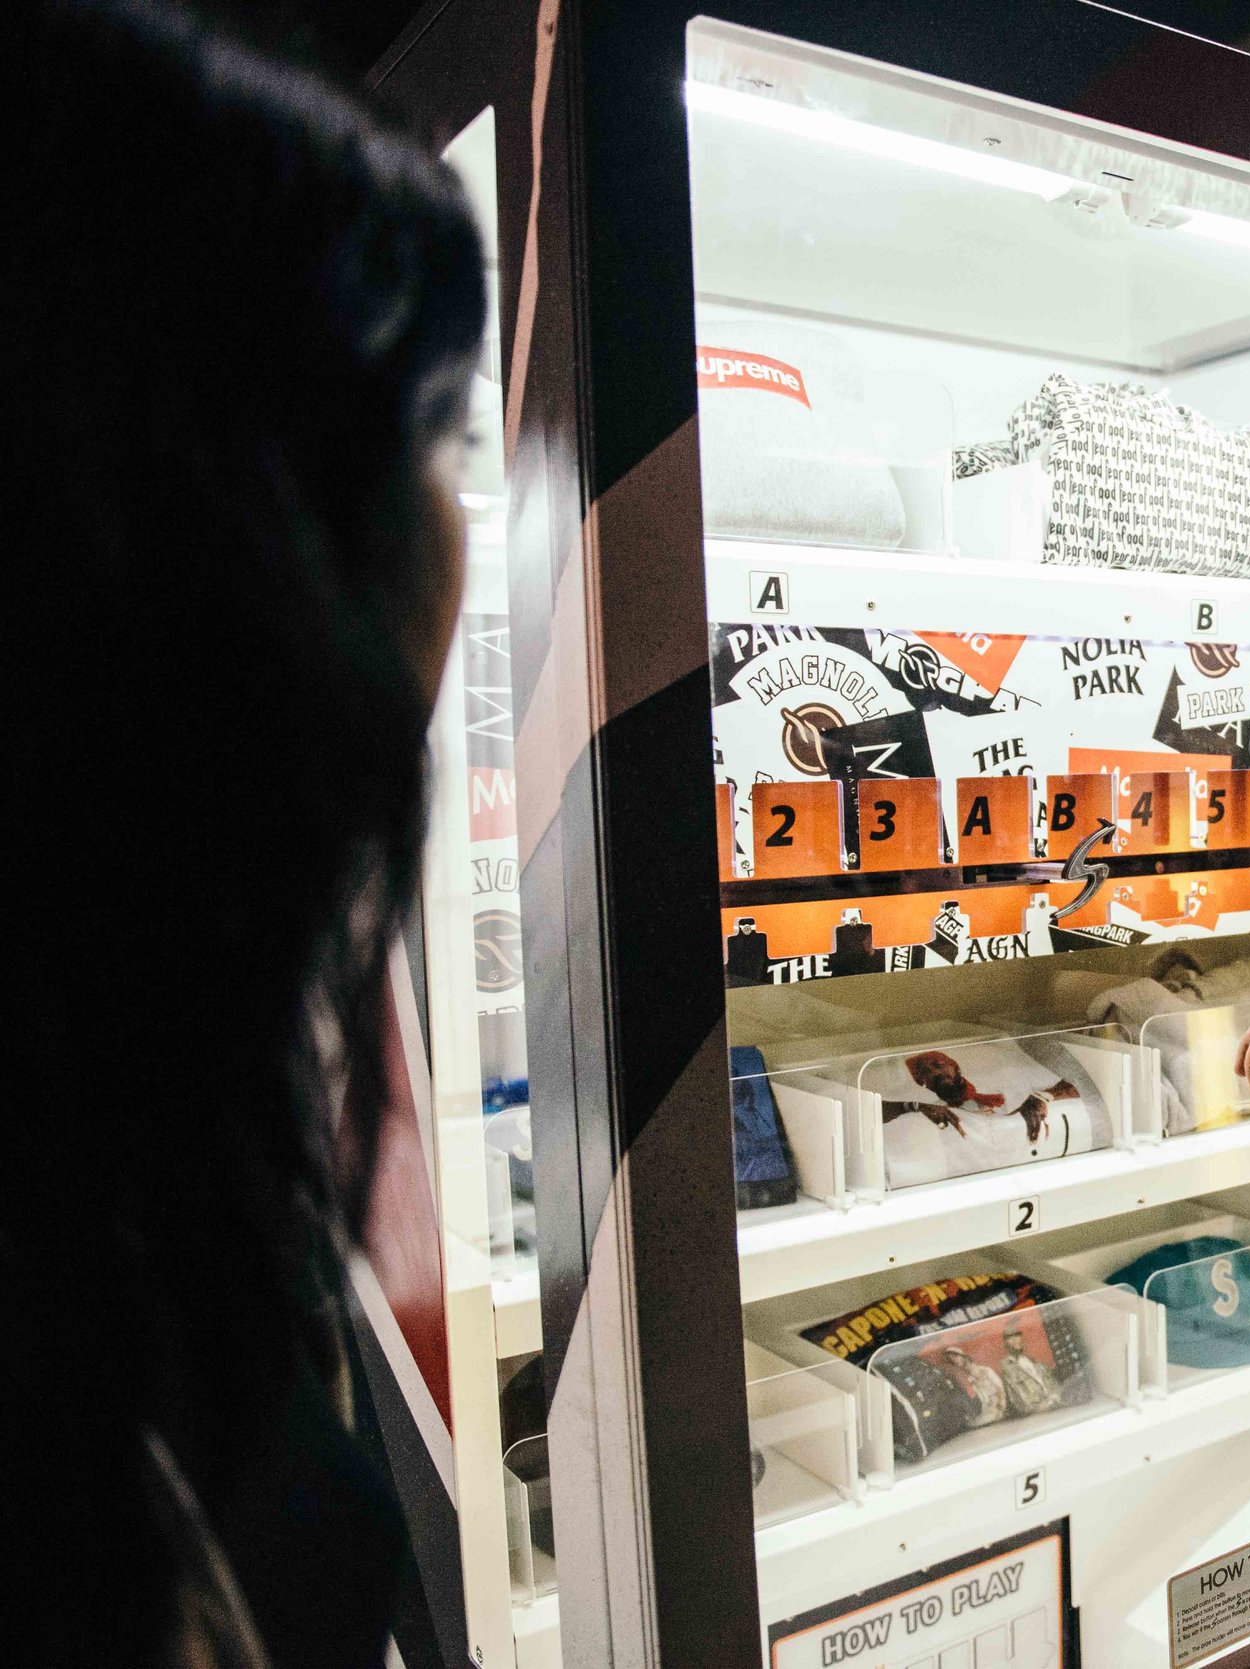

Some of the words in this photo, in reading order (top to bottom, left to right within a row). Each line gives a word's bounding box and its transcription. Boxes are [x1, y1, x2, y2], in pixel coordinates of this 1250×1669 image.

[698, 356, 800, 391] upreme
[755, 577, 785, 611] A
[1196, 604, 1213, 630] B
[1072, 663, 1144, 701] PARK
[1187, 687, 1245, 720] PARK
[973, 737, 1028, 774] THE
[869, 800, 897, 842] 3
[962, 796, 992, 836] A
[1050, 793, 1077, 832] B
[1130, 791, 1153, 827] 4
[1207, 789, 1227, 824] 5
[765, 804, 796, 847] 2
[767, 954, 833, 985] THE
[1012, 1201, 1035, 1232] 2
[1211, 1258, 1240, 1317] S
[822, 1291, 920, 1360] CAPONE
[1021, 1472, 1040, 1505] 5
[1200, 1557, 1245, 1596] HOW
[822, 1612, 893, 1668] HOW
[901, 1595, 943, 1634] TO
[951, 1562, 1025, 1616] PLAY
